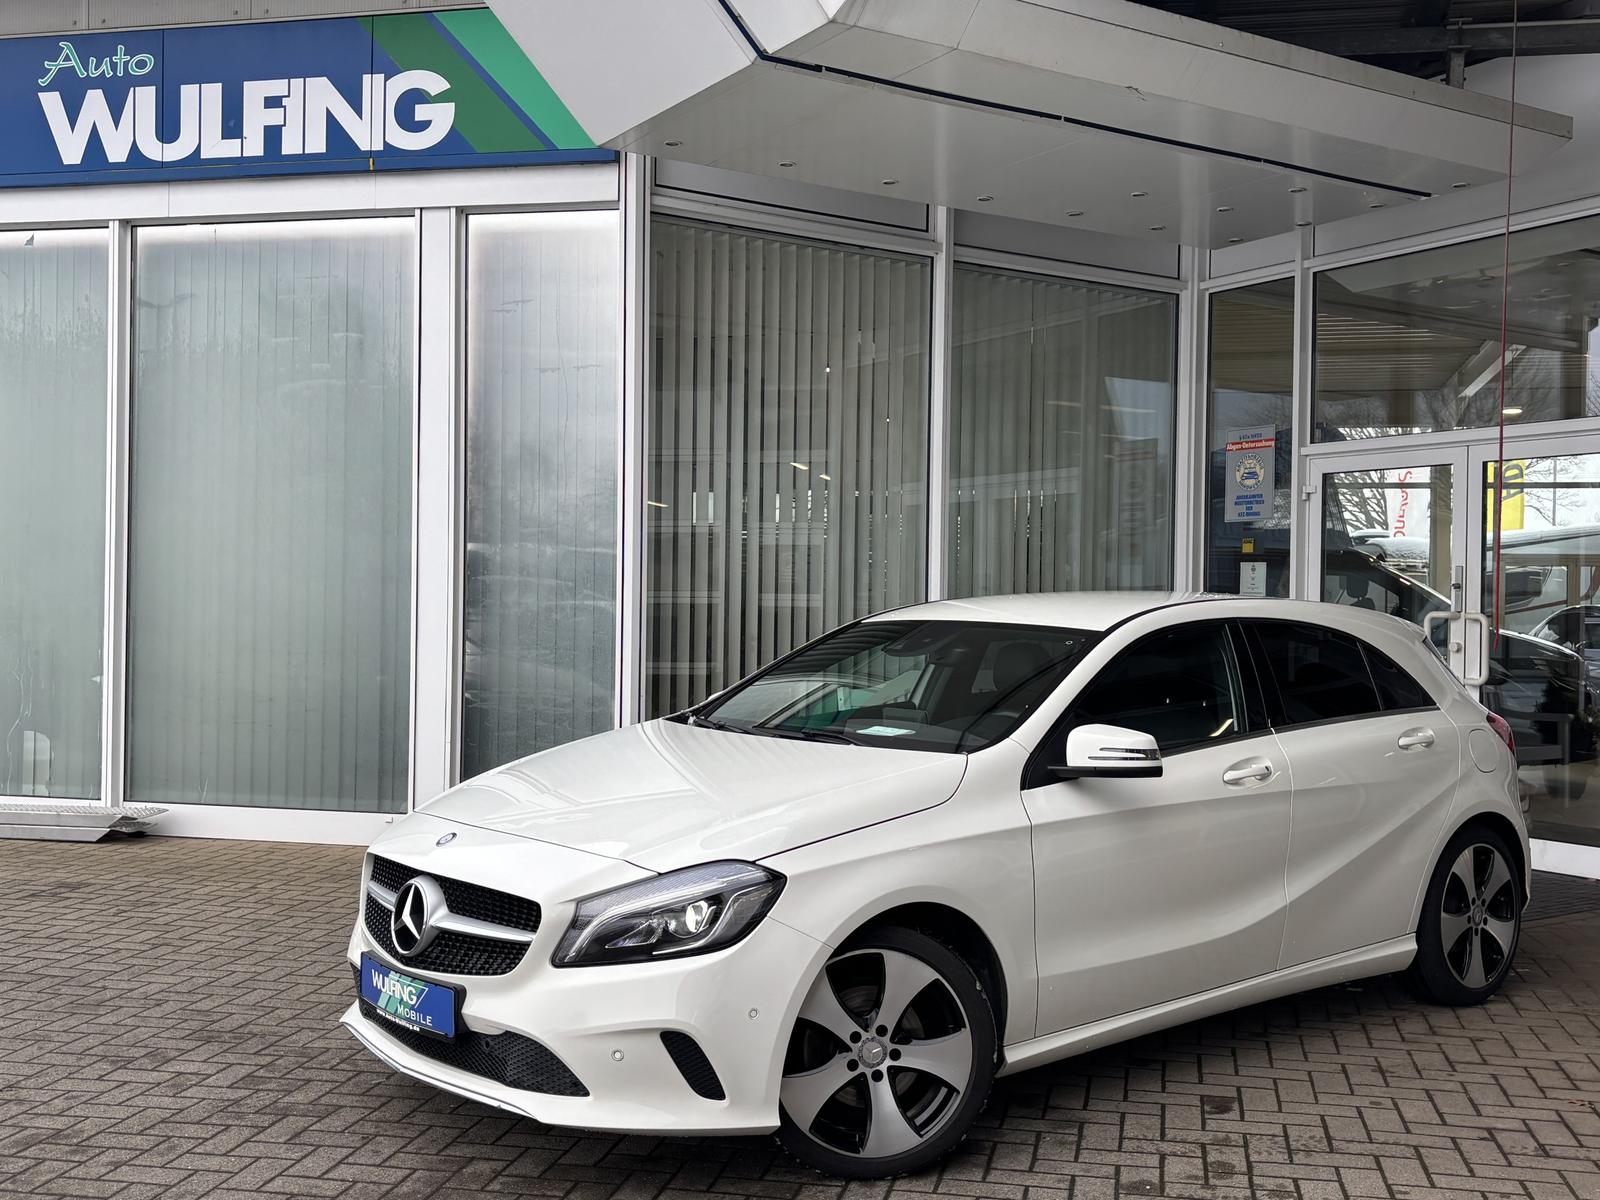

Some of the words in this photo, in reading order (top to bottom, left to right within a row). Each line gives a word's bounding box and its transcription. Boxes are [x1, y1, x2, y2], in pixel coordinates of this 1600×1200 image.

[38, 41, 154, 86] Auto
[38, 69, 456, 165] WULFING
[371, 968, 417, 1005] WULFING
[397, 1003, 433, 1026] MOBILE
